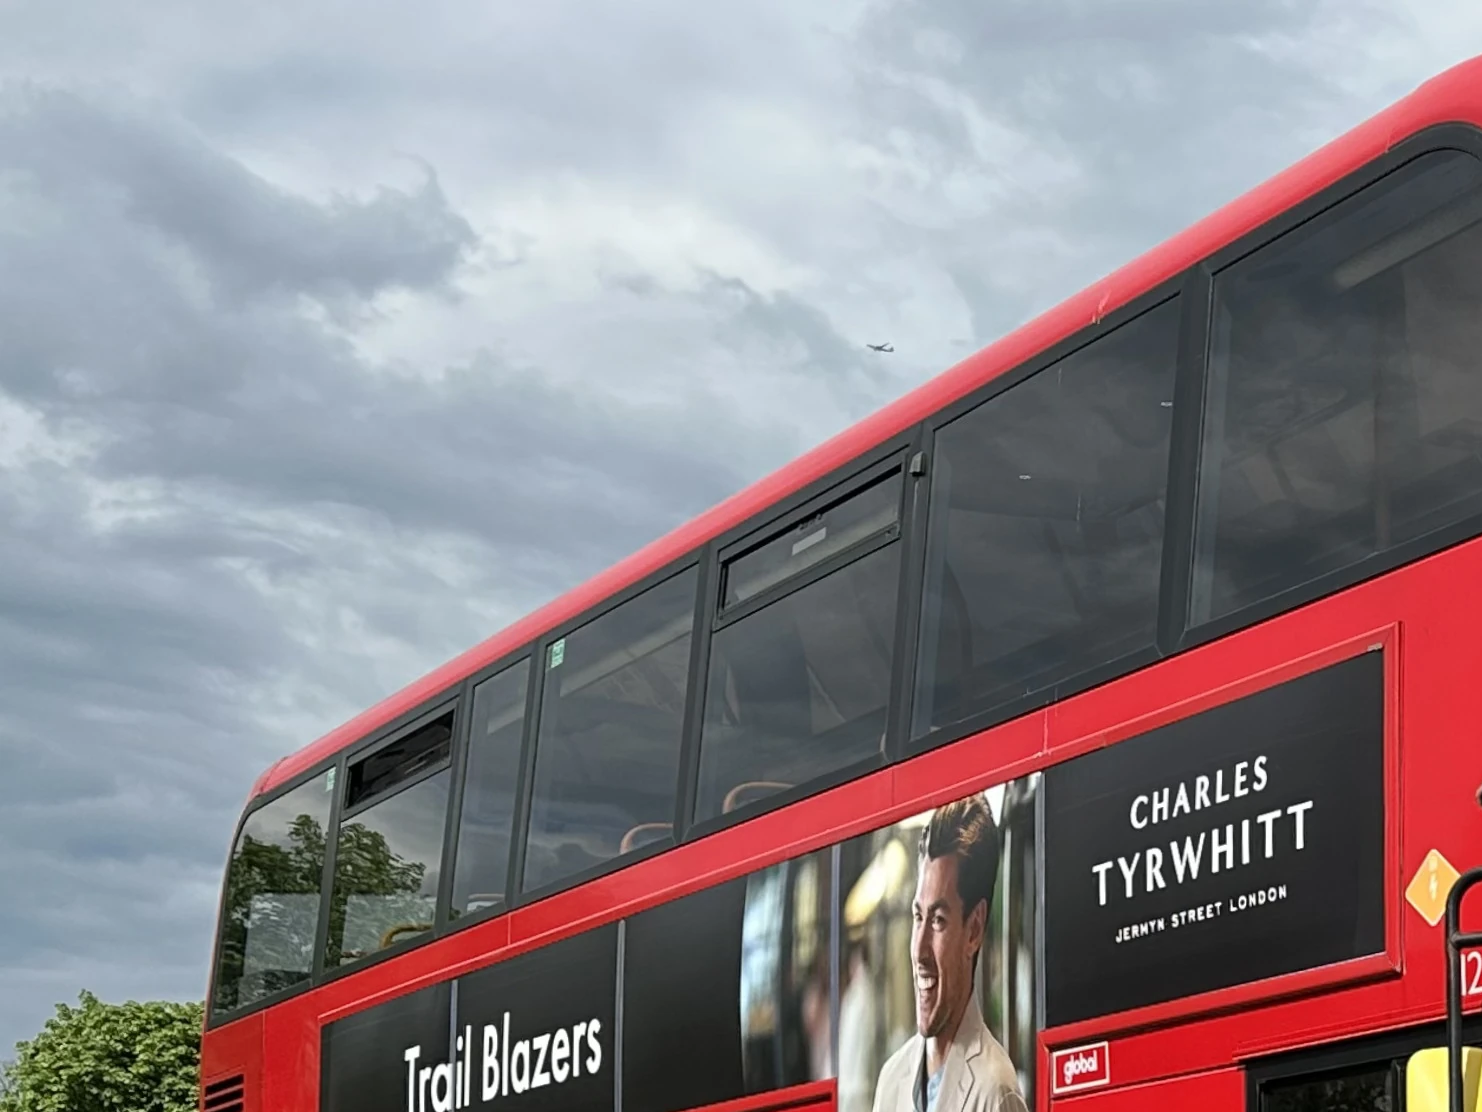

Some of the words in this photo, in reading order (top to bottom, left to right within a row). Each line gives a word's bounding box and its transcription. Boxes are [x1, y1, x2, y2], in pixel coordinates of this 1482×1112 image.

[1129, 755, 1268, 830] CHARLES
[1091, 799, 1314, 907] TYRWHITT
[1115, 917, 1166, 944] JERMYN
[1171, 901, 1223, 929] STREET
[1229, 884, 1288, 913] LONDON
[482, 1011, 602, 1102] Blazers
[1063, 1049, 1098, 1085] global
